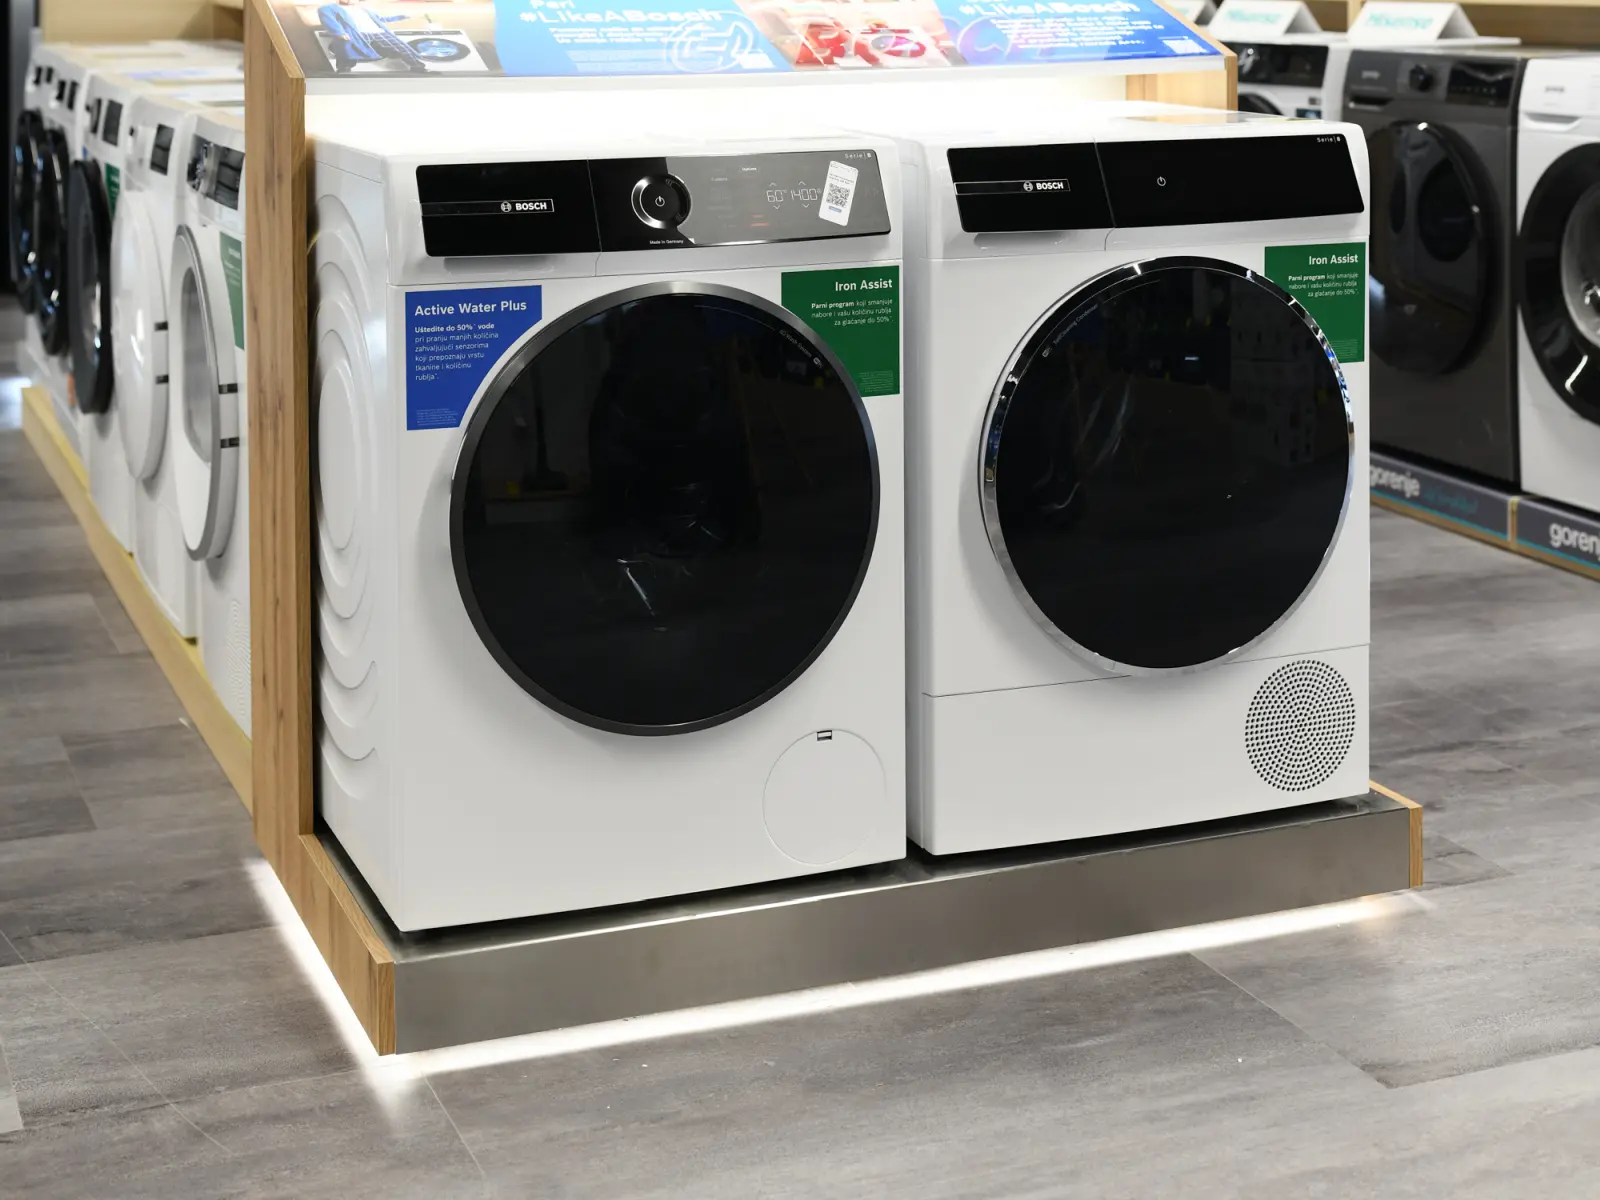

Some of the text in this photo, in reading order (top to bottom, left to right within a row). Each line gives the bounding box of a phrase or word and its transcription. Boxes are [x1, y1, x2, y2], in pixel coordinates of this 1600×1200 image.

[519, 8, 723, 23] #LikeABosch
[1036, 181, 1064, 190] BOSCH
[791, 188, 818, 201] 1400
[515, 202, 547, 211] BOSCH
[1309, 253, 1358, 265] Iron Assist
[1303, 274, 1325, 282] program
[835, 278, 893, 292] Iron Assist
[414, 300, 527, 316] Active Water Plus
[829, 301, 854, 309] program
[868, 298, 893, 306] smanjuje
[875, 307, 891, 315] rublja
[415, 325, 444, 333] Uštedite
[415, 336, 425, 344] pri
[426, 335, 447, 343] pranju
[429, 353, 466, 362] prepoznaju
[1550, 523, 1600, 562] goren
